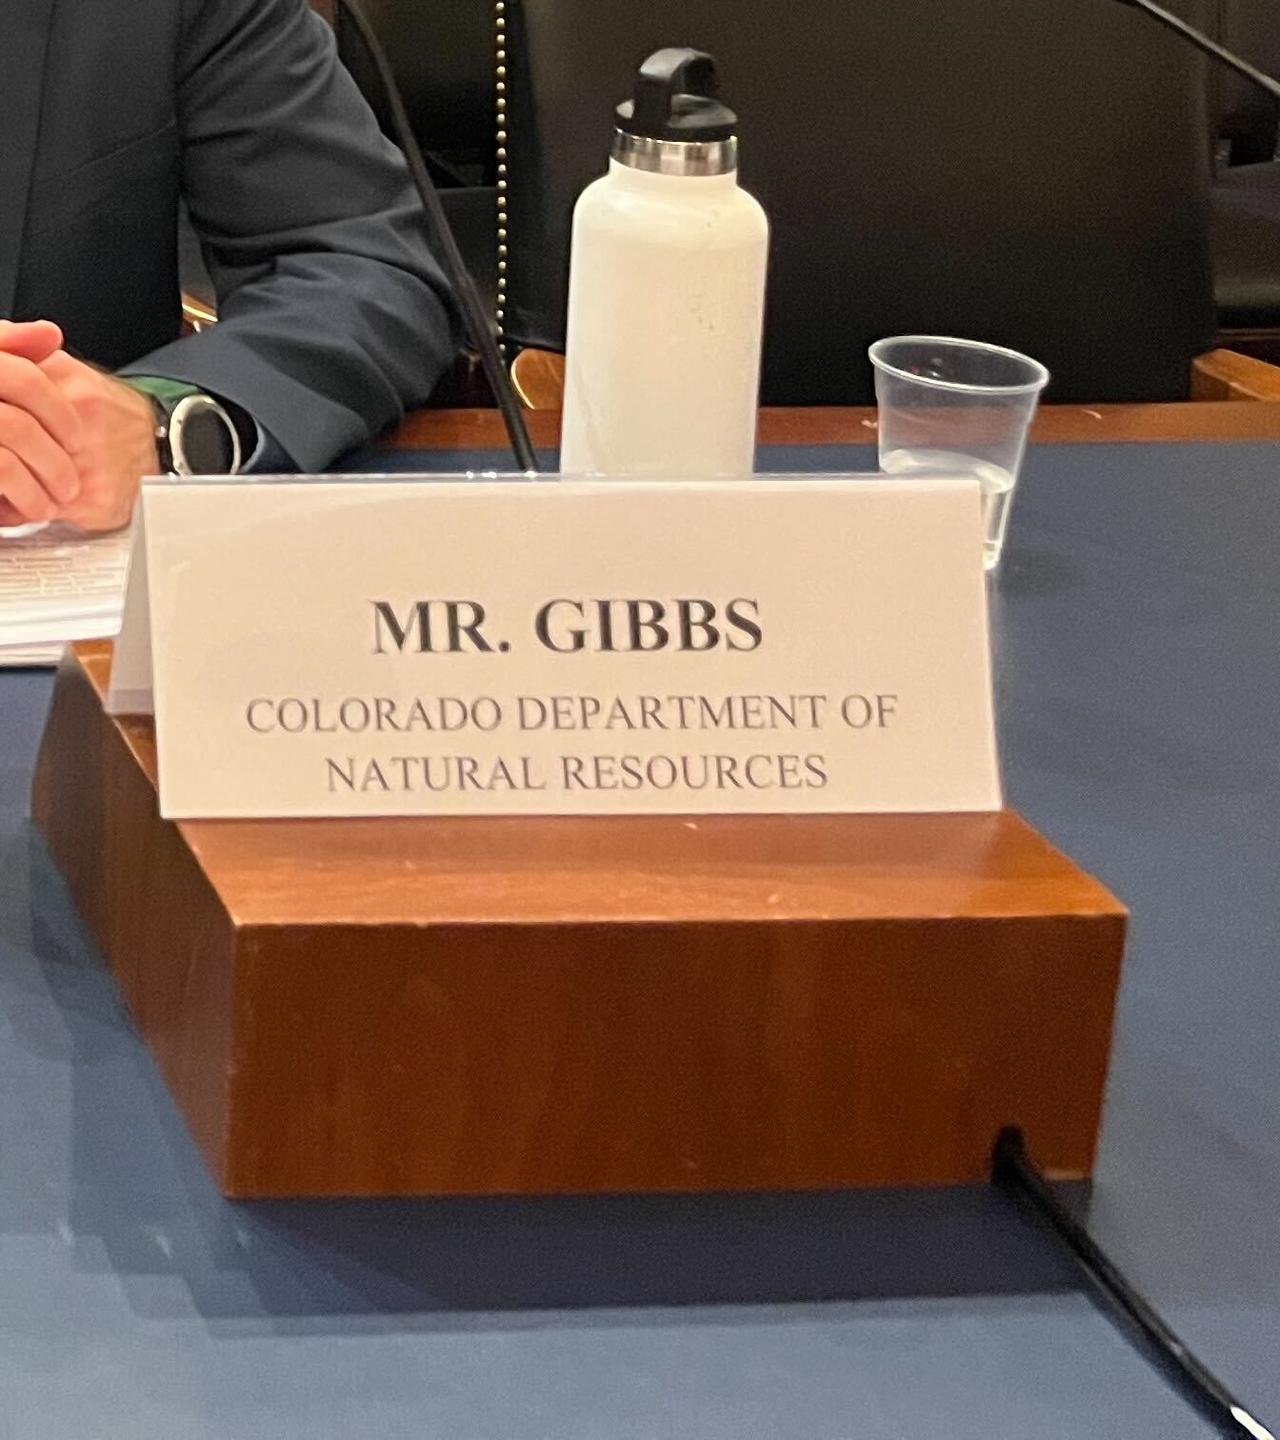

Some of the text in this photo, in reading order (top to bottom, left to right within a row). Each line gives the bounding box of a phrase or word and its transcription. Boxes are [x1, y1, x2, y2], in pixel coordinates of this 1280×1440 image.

[370, 597, 764, 654] MR. GIBBS
[246, 694, 899, 732] COLORADO DEPARTMENT OF
[325, 754, 829, 792] NATURAL RESOURCES
